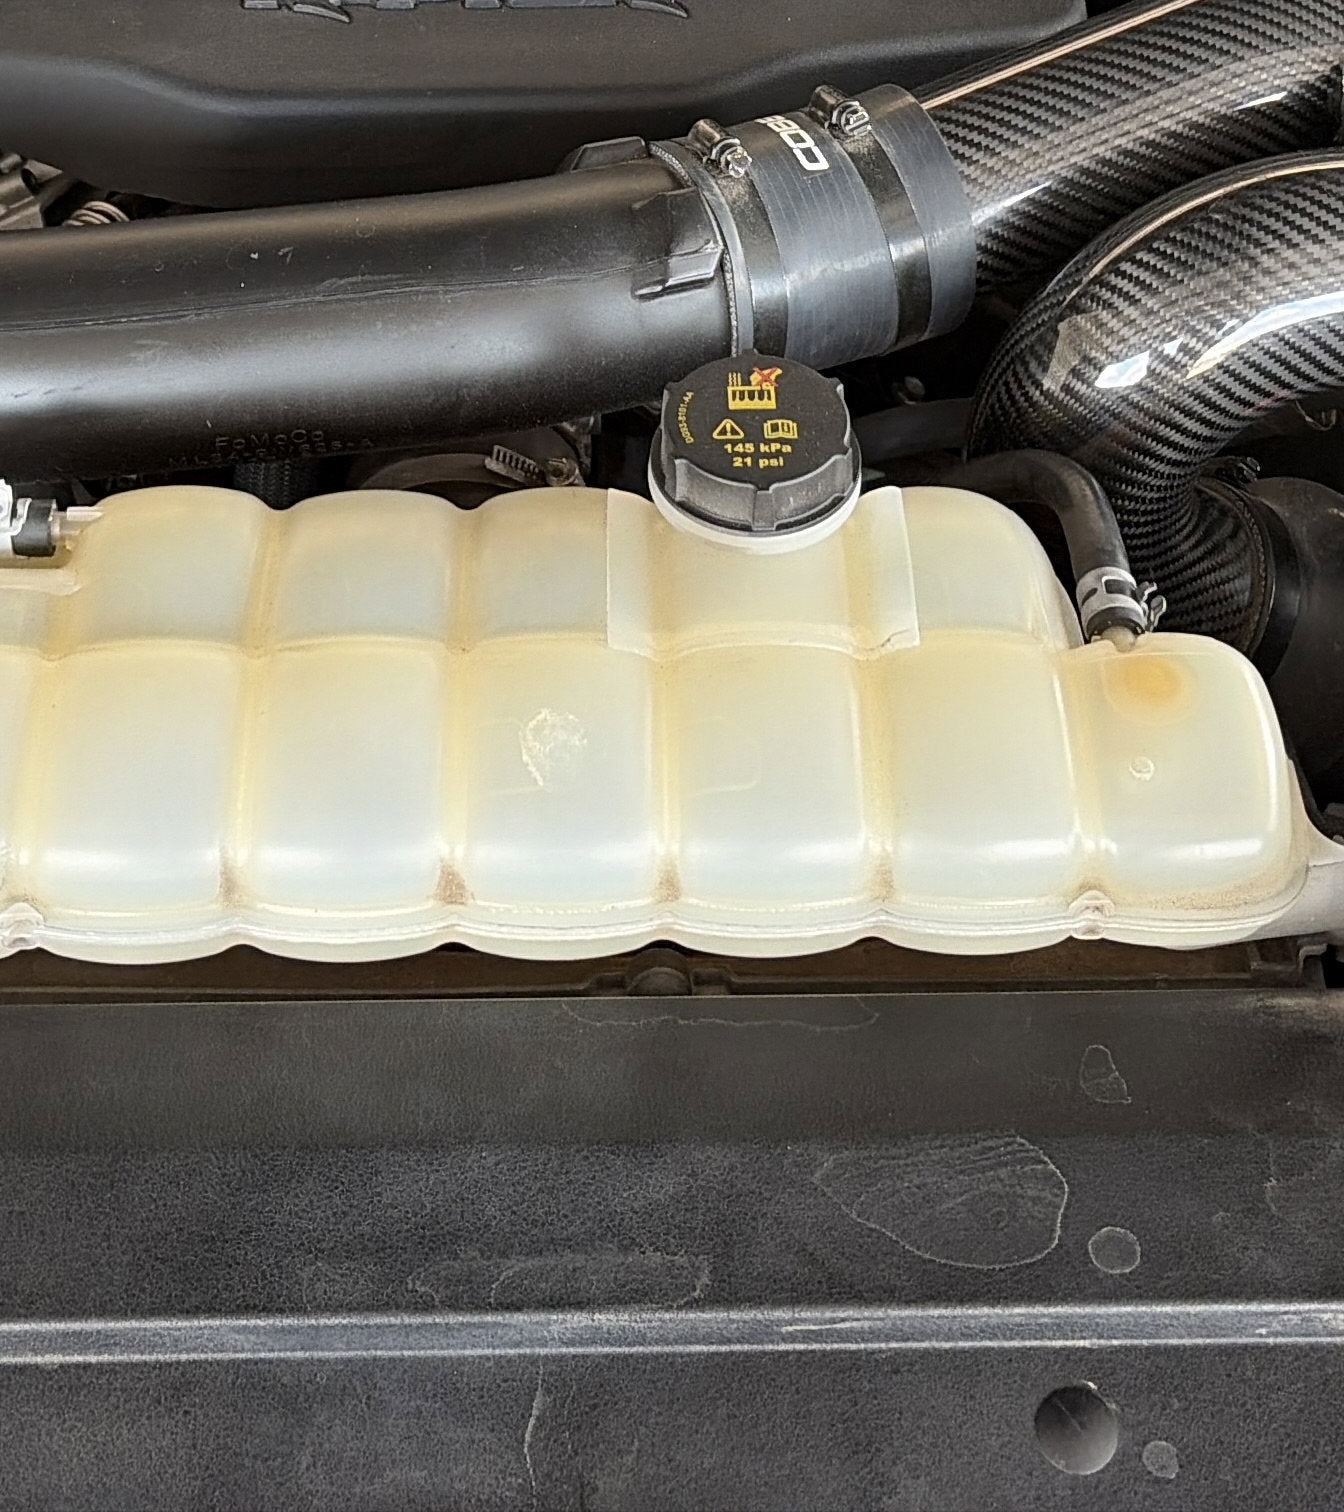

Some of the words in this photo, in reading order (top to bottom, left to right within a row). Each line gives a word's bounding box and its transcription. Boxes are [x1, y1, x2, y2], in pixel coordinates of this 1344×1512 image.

[723, 442, 755, 454] 145
[759, 442, 792, 454] kPa
[732, 456, 752, 467] 21
[759, 456, 784, 469] psi
